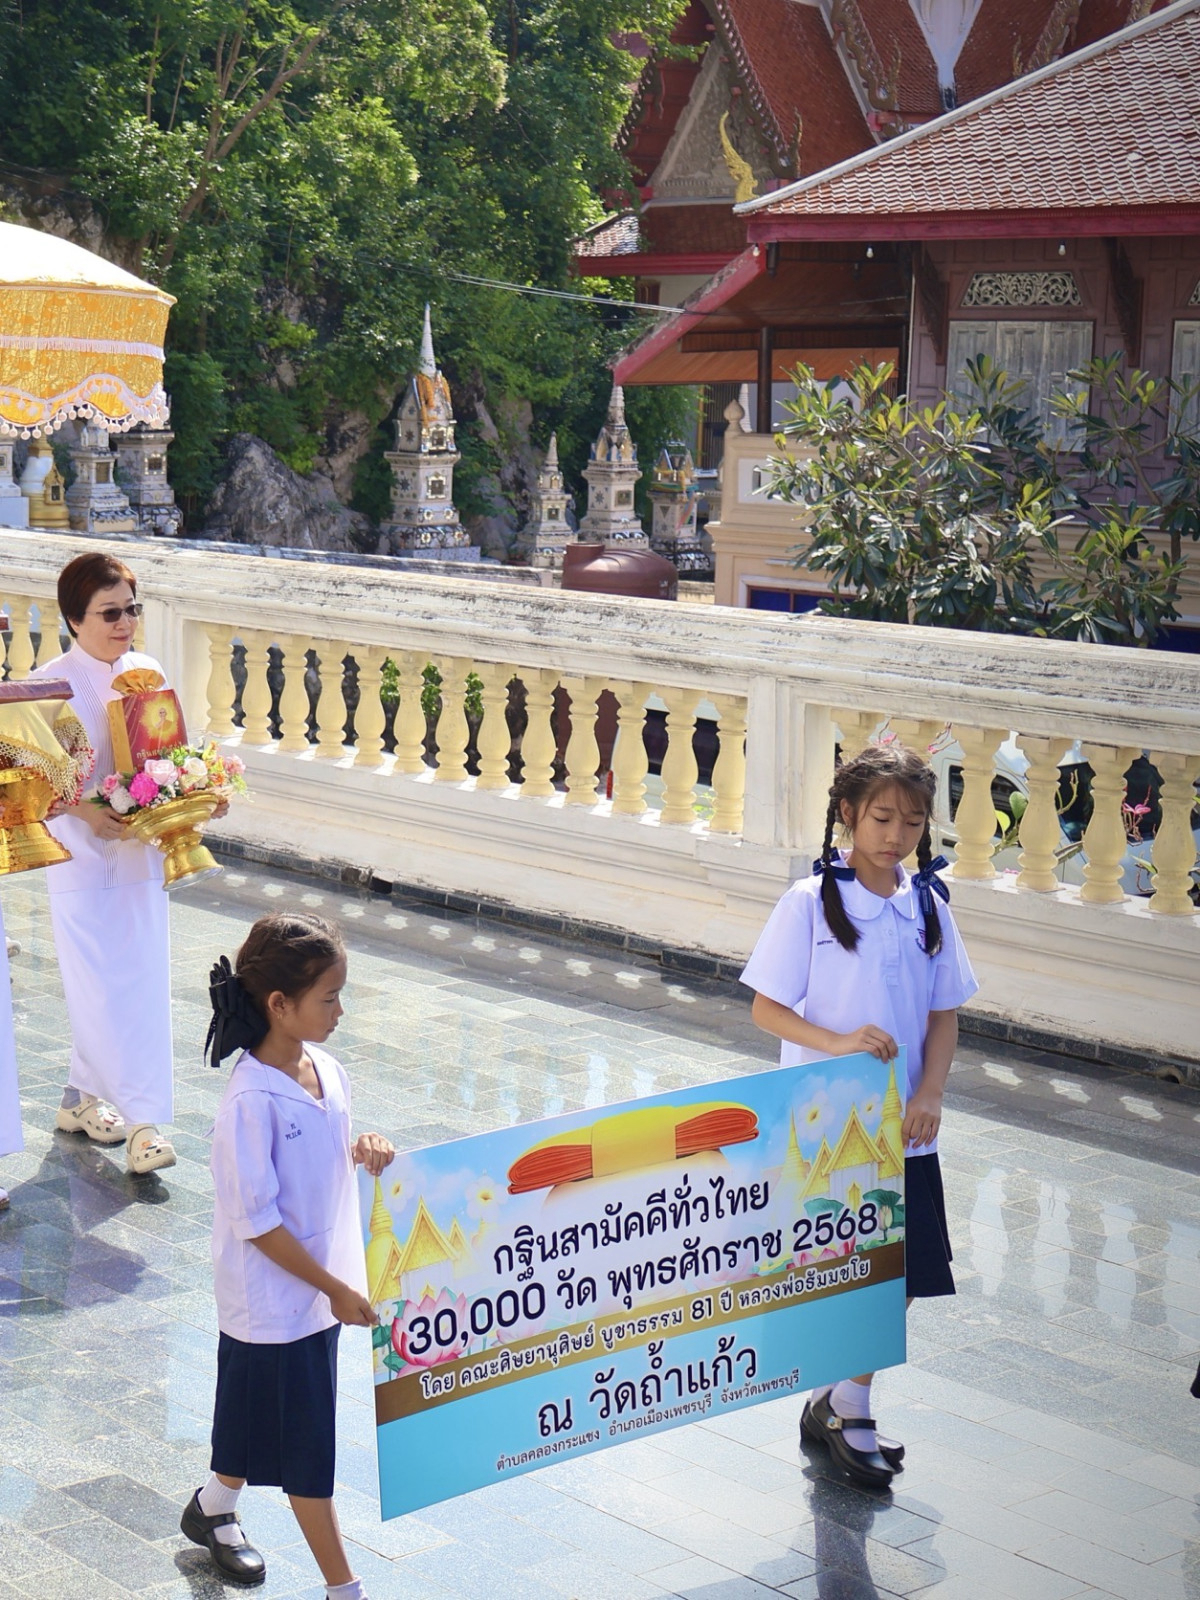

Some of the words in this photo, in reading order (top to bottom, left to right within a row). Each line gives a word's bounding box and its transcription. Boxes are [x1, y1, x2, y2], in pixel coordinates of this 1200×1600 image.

[408, 1282, 545, 1355] 30,000
[557, 1267, 597, 1310] วัด
[608, 1228, 782, 1310] พุทธศักราช
[792, 1203, 878, 1253] 2568
[494, 1173, 769, 1281] กฐินสามัคคีทั่วไทย
[421, 1372, 454, 1398] โดย
[461, 1324, 595, 1385] คณะศิษยานุศิษย์
[601, 1308, 682, 1348] บูชาธรรม
[691, 1297, 713, 1321] 81
[720, 1288, 733, 1312] ปี
[738, 1258, 870, 1308] หลวงพ่อธัมมชโย
[496, 1428, 600, 1471] ตำบลคลองกระแชง
[608, 1393, 712, 1436] อำเภอเมืองเพชรบุรี
[720, 1368, 800, 1404] จังหวัดเพชรบุรี
[538, 1398, 572, 1437] ณ
[589, 1336, 757, 1420] วัดถ้ำแก้ว
